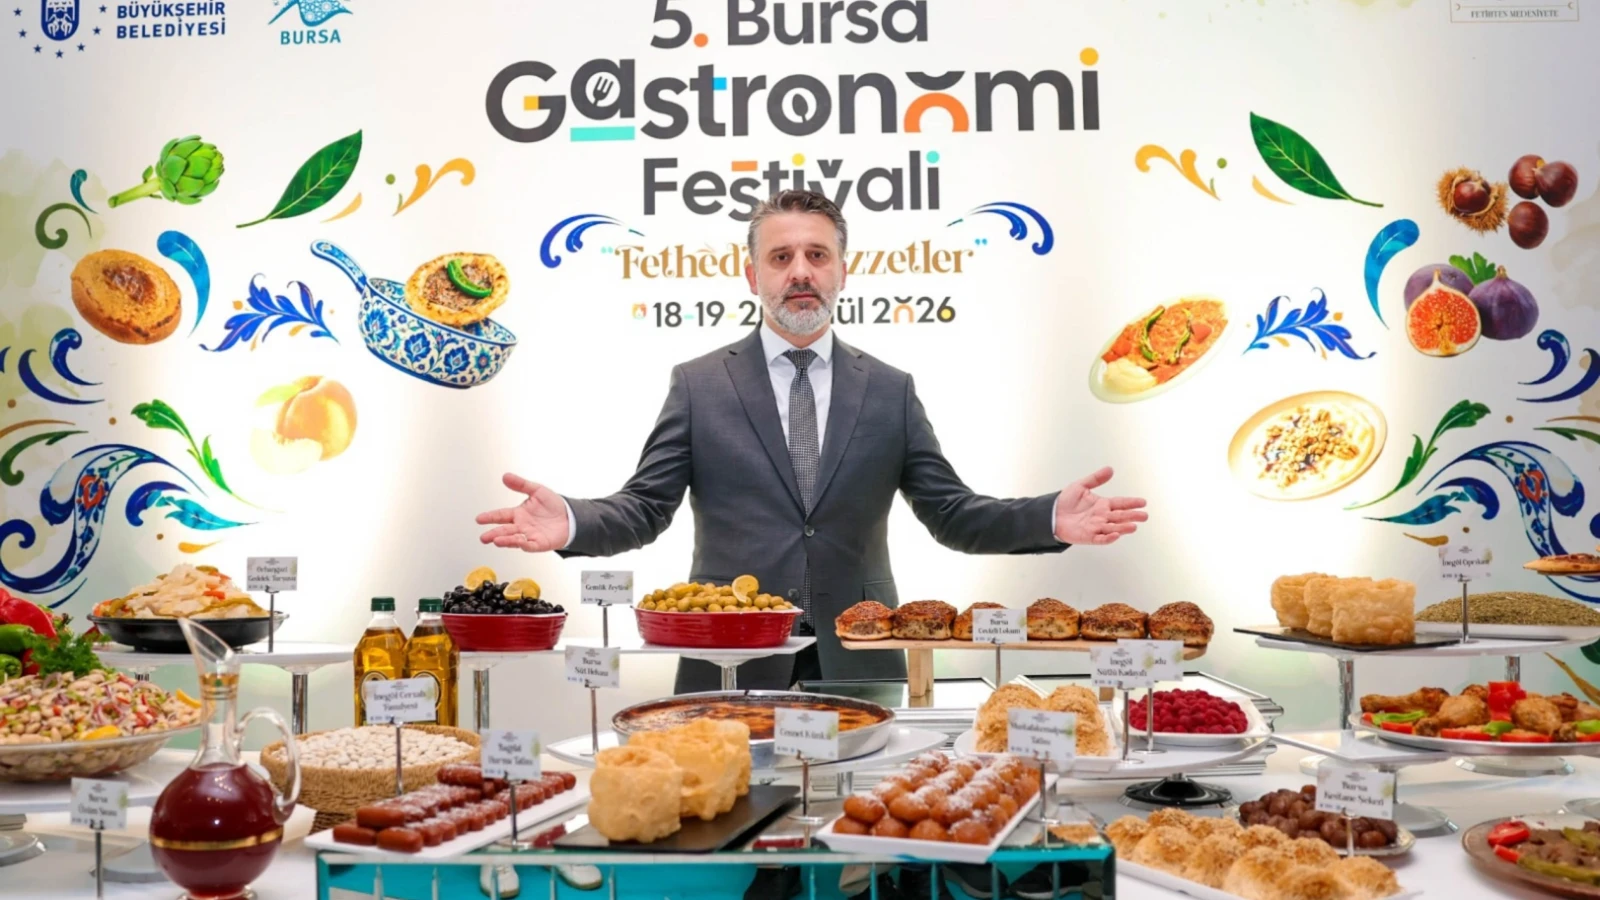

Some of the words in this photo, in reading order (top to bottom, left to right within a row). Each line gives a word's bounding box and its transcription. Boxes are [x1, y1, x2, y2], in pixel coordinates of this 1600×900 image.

[116, 0, 226, 19] BÜYÜKŞEHİR
[1510, 9, 1559, 18] MEDENİYETE
[116, 17, 226, 39] BELEDİYESİ
[650, 0, 709, 49] 5.
[727, 0, 928, 46] Bursa
[280, 29, 342, 45] BURSA
[485, 47, 1100, 143] Gastronomi
[872, 296, 956, 325] 2026
[990, 618, 1009, 626] Bursa
[582, 657, 602, 665] Bursa
[1110, 656, 1133, 668] İnegöl
[1341, 780, 1368, 792] Bursa
[1324, 790, 1356, 802] Kestane
